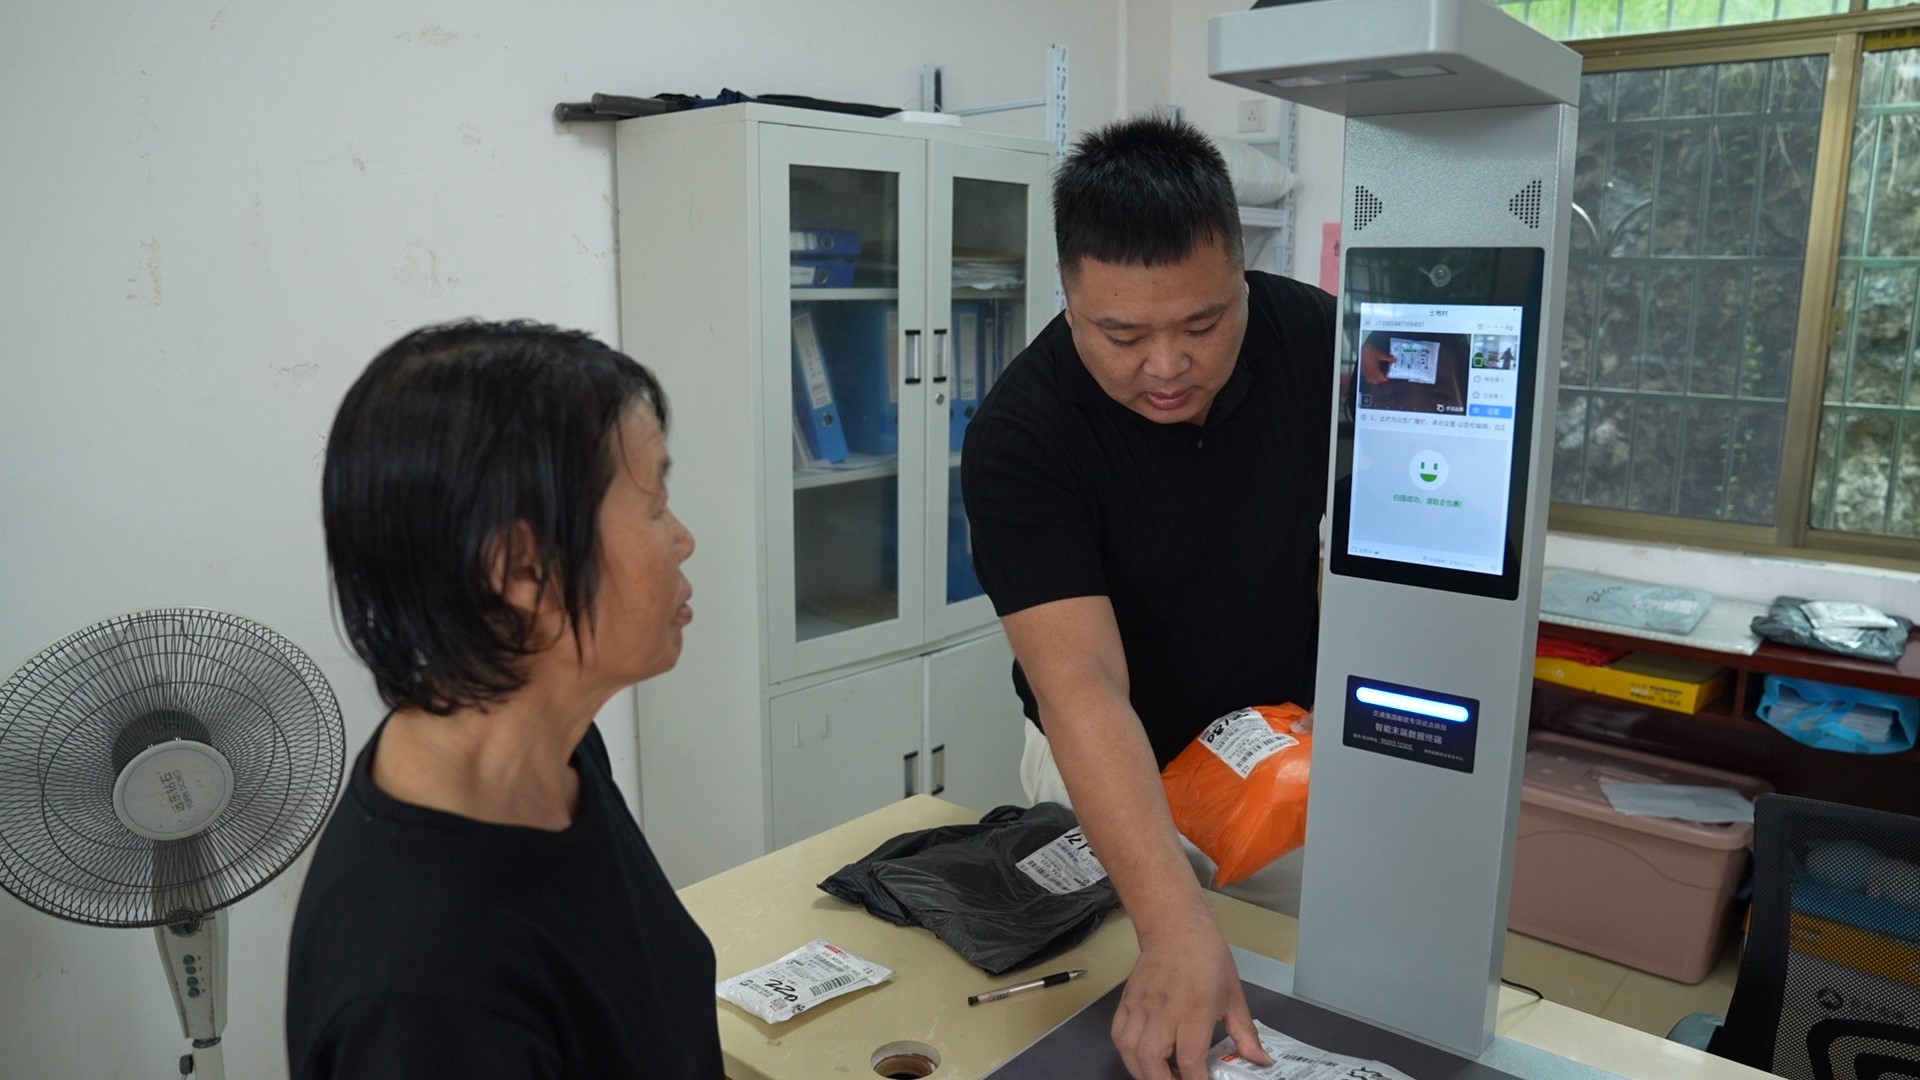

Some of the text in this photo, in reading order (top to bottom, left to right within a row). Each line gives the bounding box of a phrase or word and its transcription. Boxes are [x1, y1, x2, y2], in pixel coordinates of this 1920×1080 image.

[1375, 722, 1443, 745] 智能末端数据终端
[160, 772, 185, 814] 远东钻石
